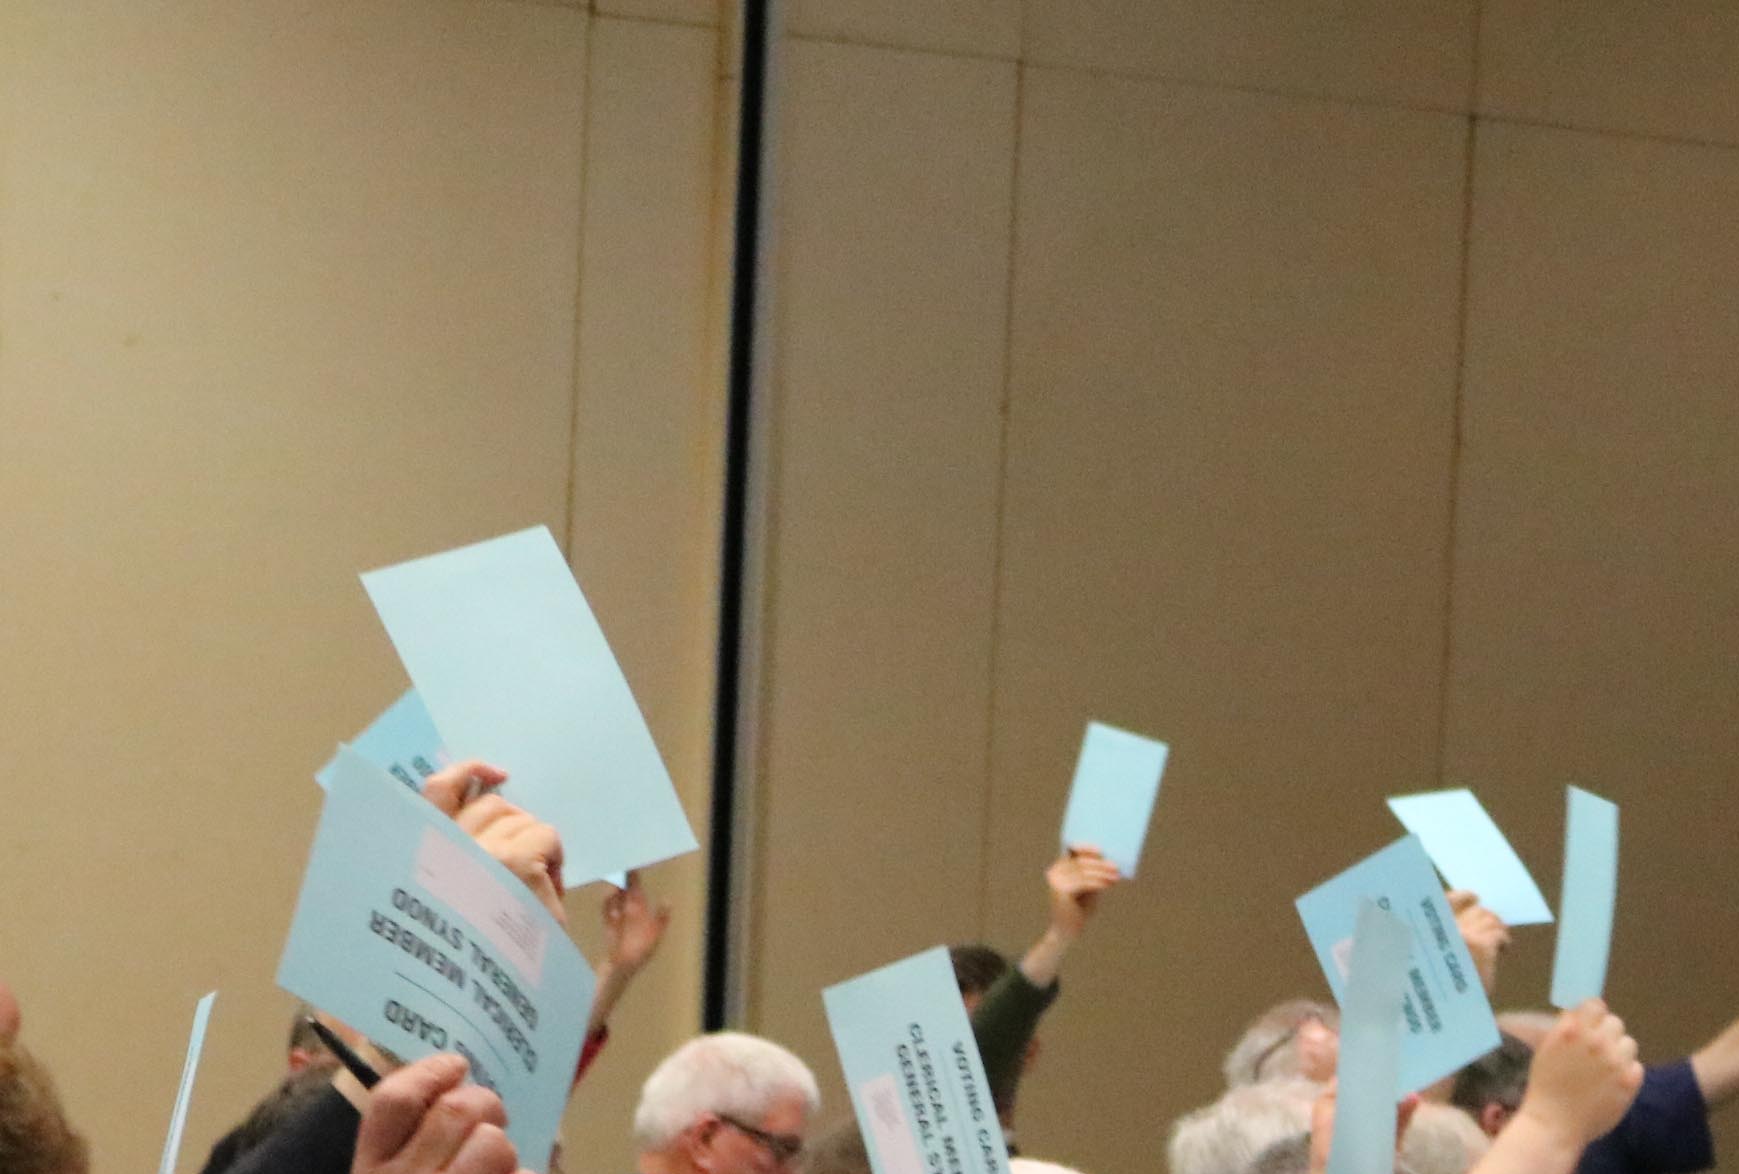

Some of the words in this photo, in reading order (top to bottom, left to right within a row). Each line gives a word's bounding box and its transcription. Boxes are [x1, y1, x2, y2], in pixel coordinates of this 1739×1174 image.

[369, 910, 466, 989] MEMBER
[391, 887, 465, 951] SYNOD
[384, 998, 448, 1051] CARD
[469, 938, 539, 1032] GENERAL
[471, 978, 538, 1074] CLERICAL
[897, 1043, 930, 1147] GENERAL
[908, 1022, 947, 1130] CLERICAL
[952, 1041, 983, 1121] VOTING
